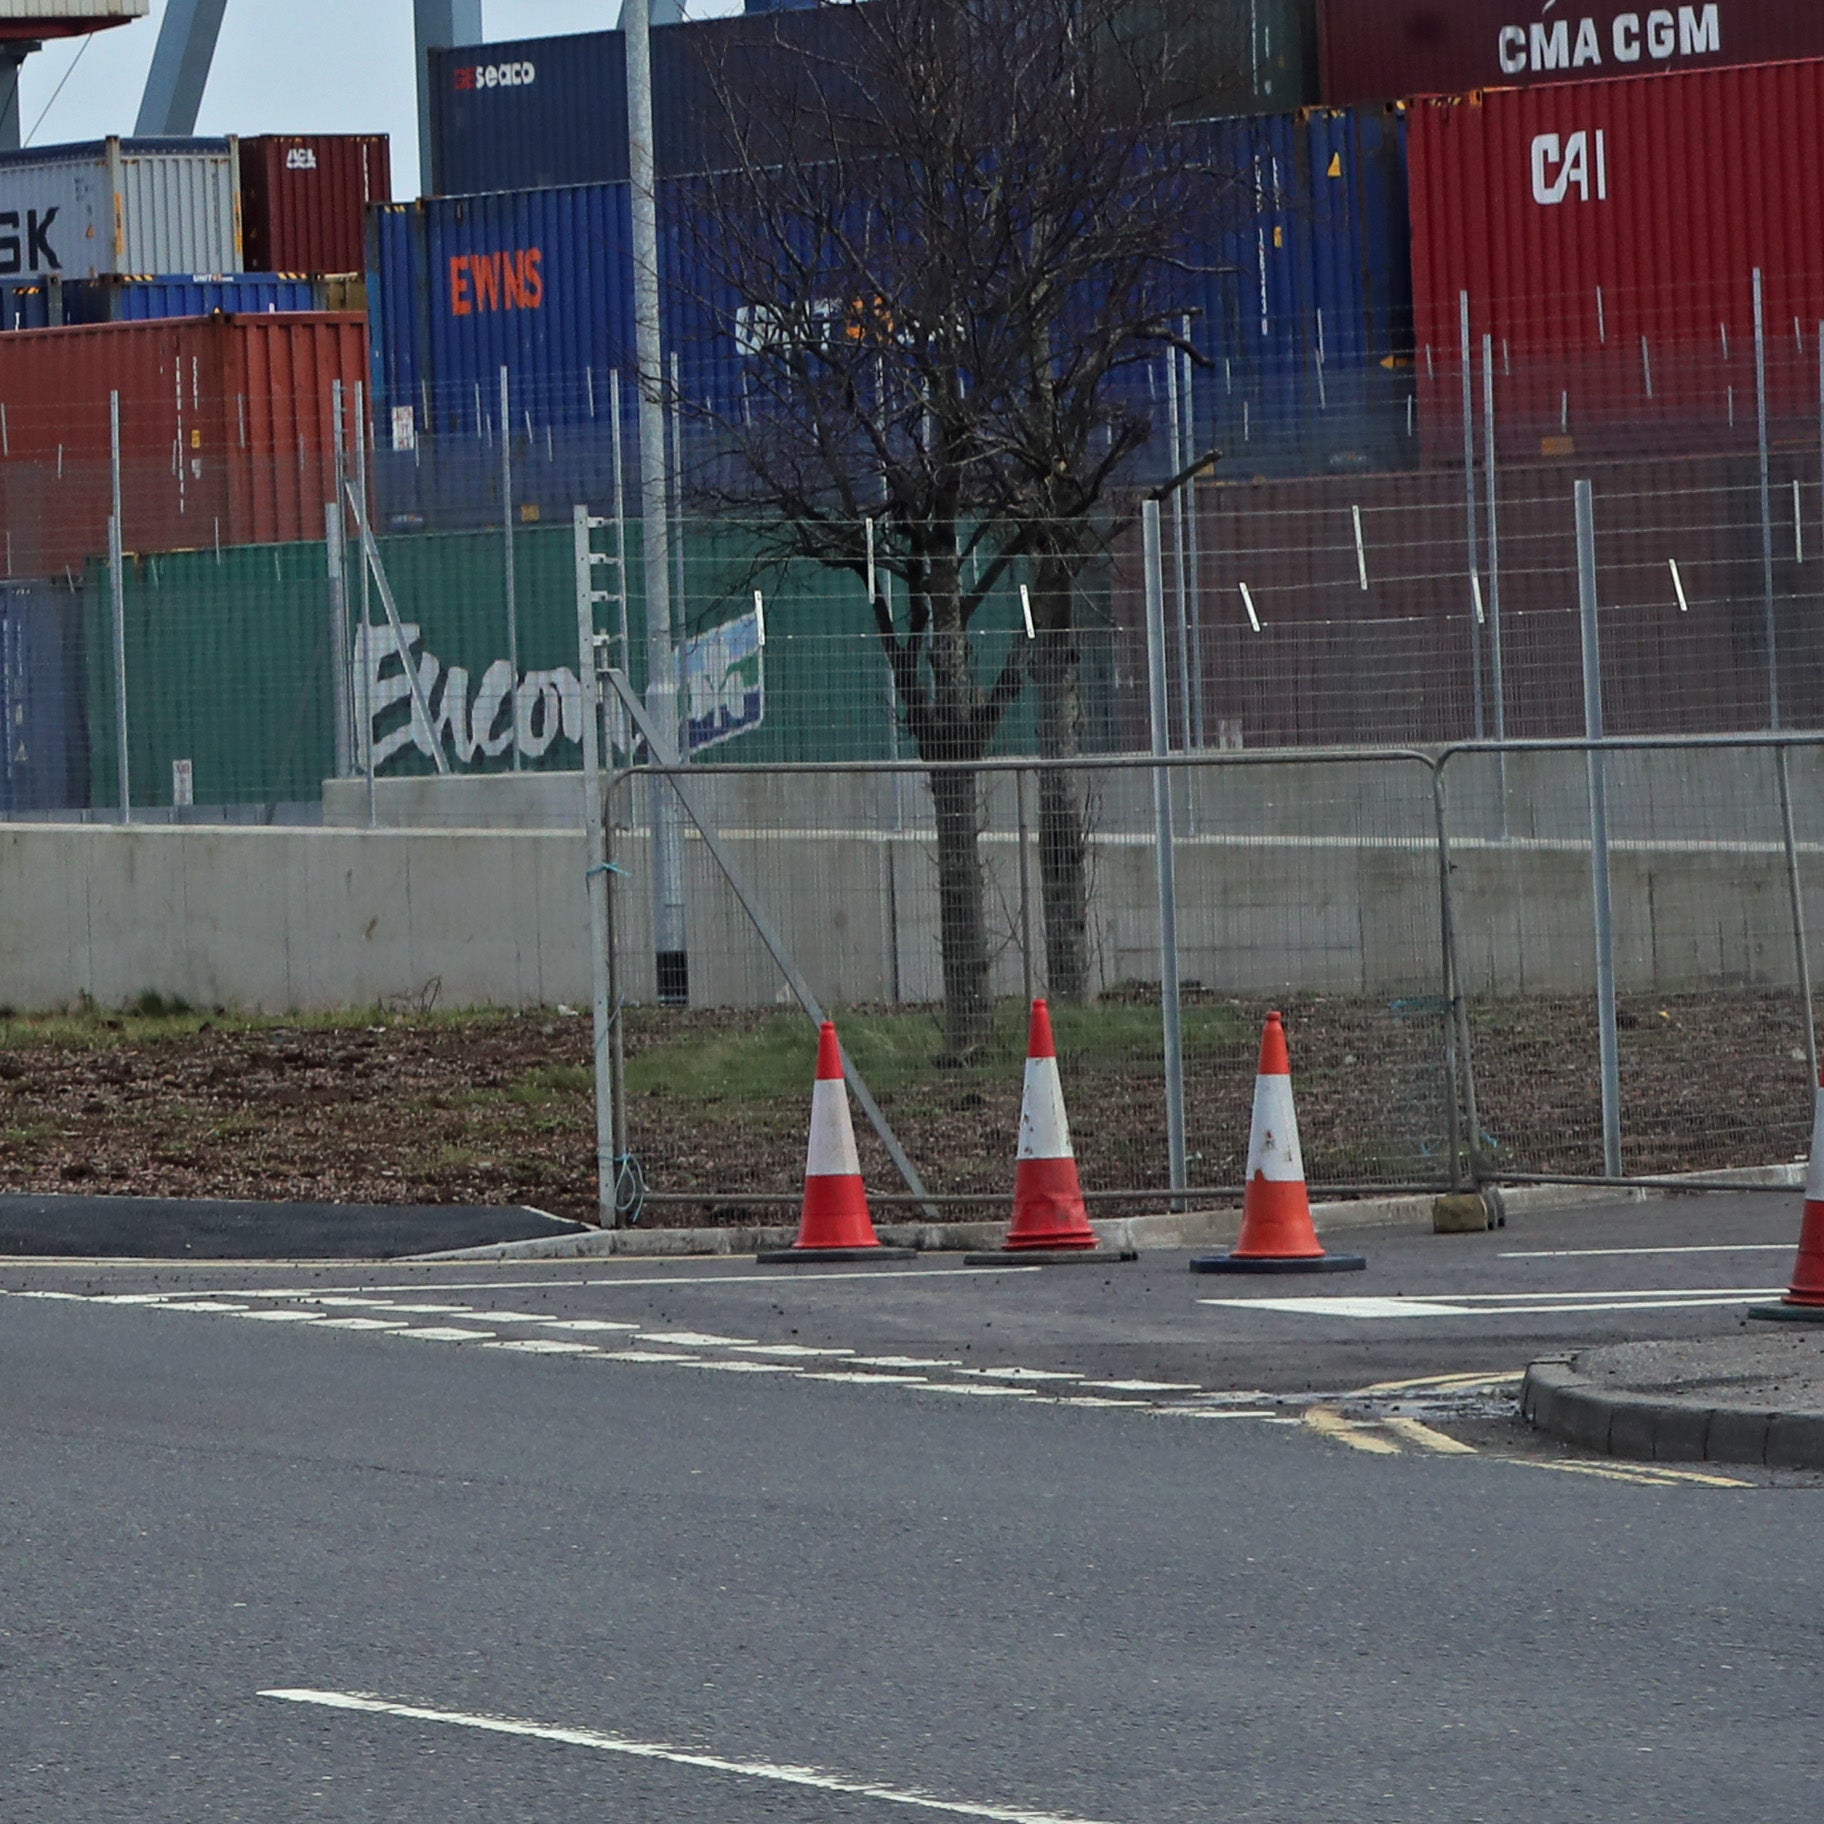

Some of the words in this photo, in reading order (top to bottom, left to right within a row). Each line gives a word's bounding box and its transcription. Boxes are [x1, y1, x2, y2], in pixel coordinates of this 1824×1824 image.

[1498, 17, 1602, 74] CMA
[1612, 3, 1720, 63] CGM
[1531, 129, 1606, 205] CAI
